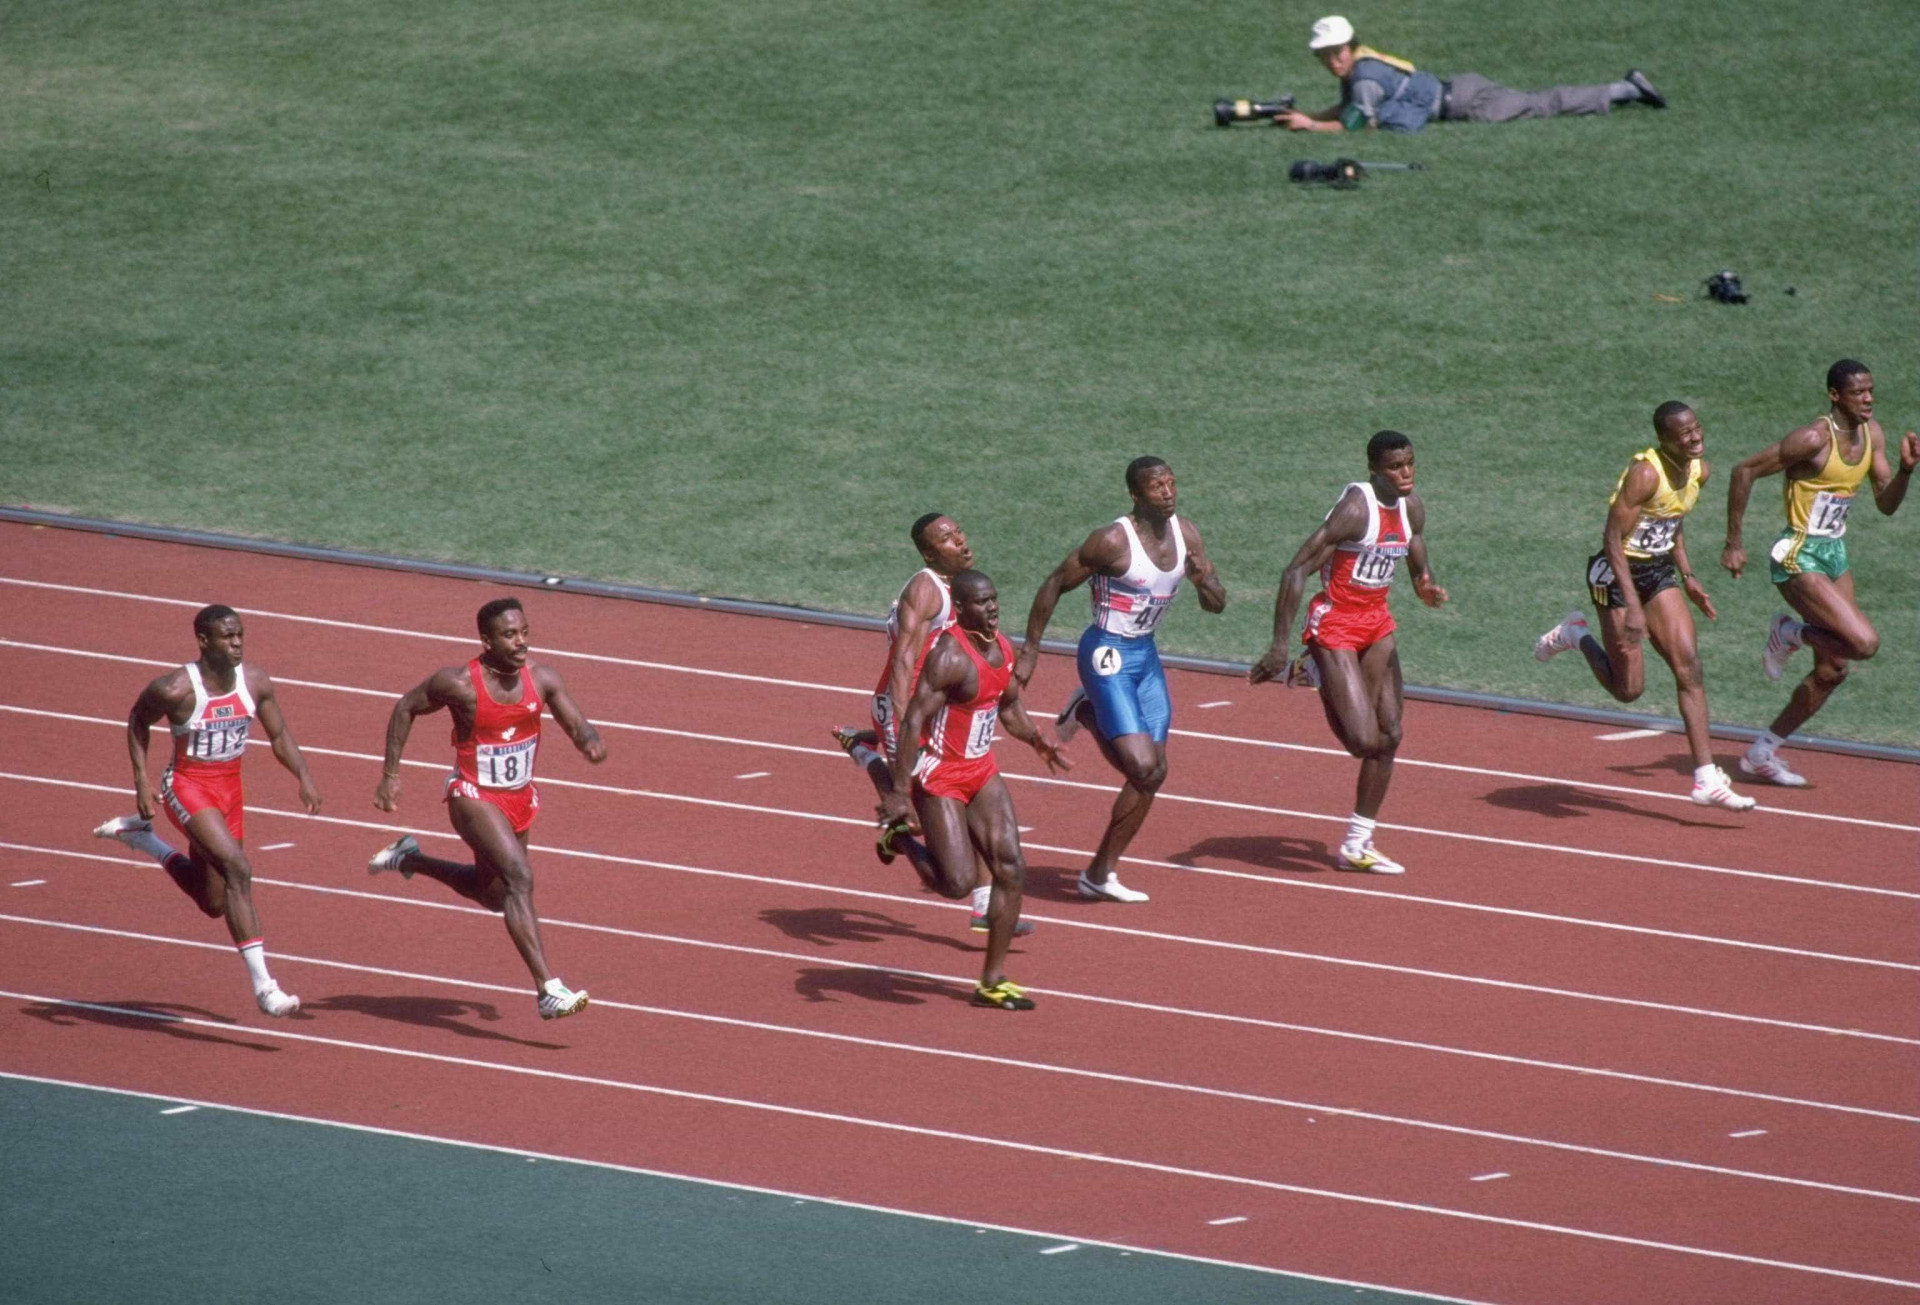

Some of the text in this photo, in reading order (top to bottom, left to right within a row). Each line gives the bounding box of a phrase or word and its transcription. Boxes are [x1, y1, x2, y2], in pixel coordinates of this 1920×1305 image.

[1595, 559, 1609, 585] 2
[876, 695, 887, 724] 5
[490, 750, 529, 783] 181
